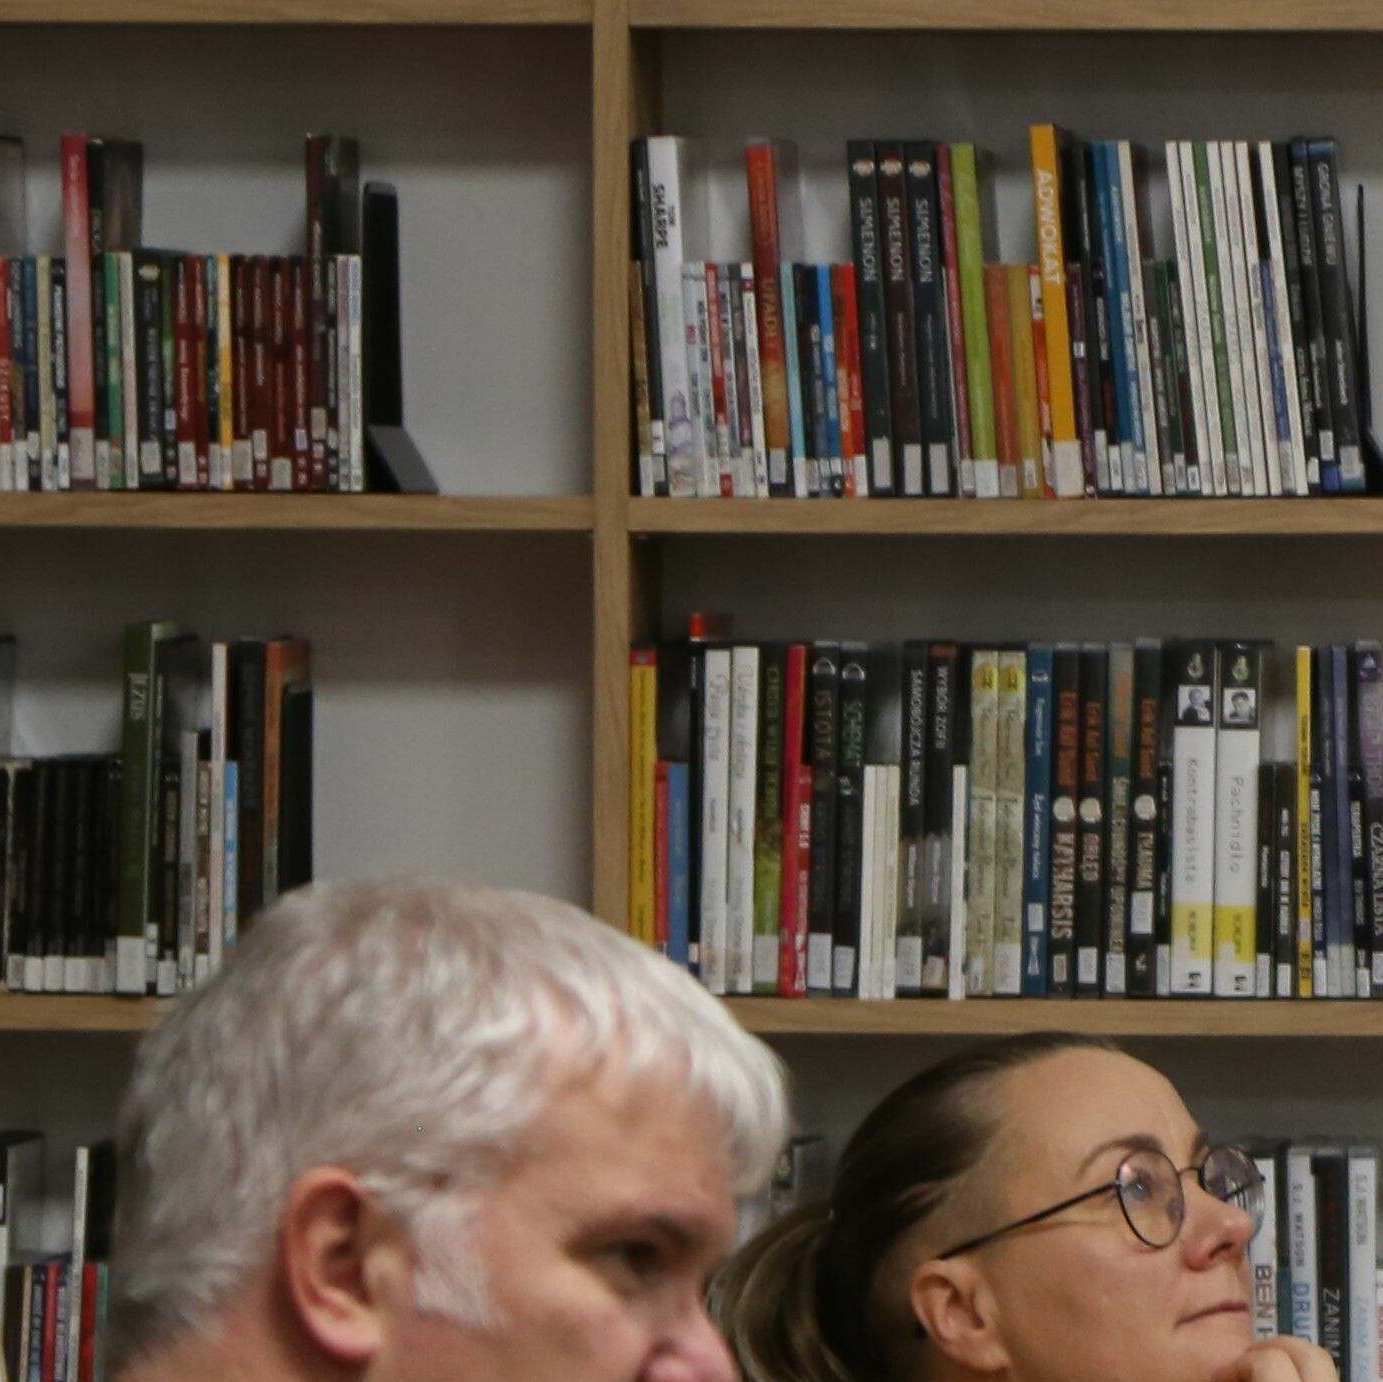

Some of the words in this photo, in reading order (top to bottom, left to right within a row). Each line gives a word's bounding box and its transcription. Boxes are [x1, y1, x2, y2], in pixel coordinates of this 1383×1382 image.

[653, 184, 668, 249] SHARPE
[858, 197, 877, 282] SIMENON
[886, 196, 904, 282] SIMENON
[915, 198, 932, 283] SIMENON
[1037, 170, 1061, 284] ADWOKAT
